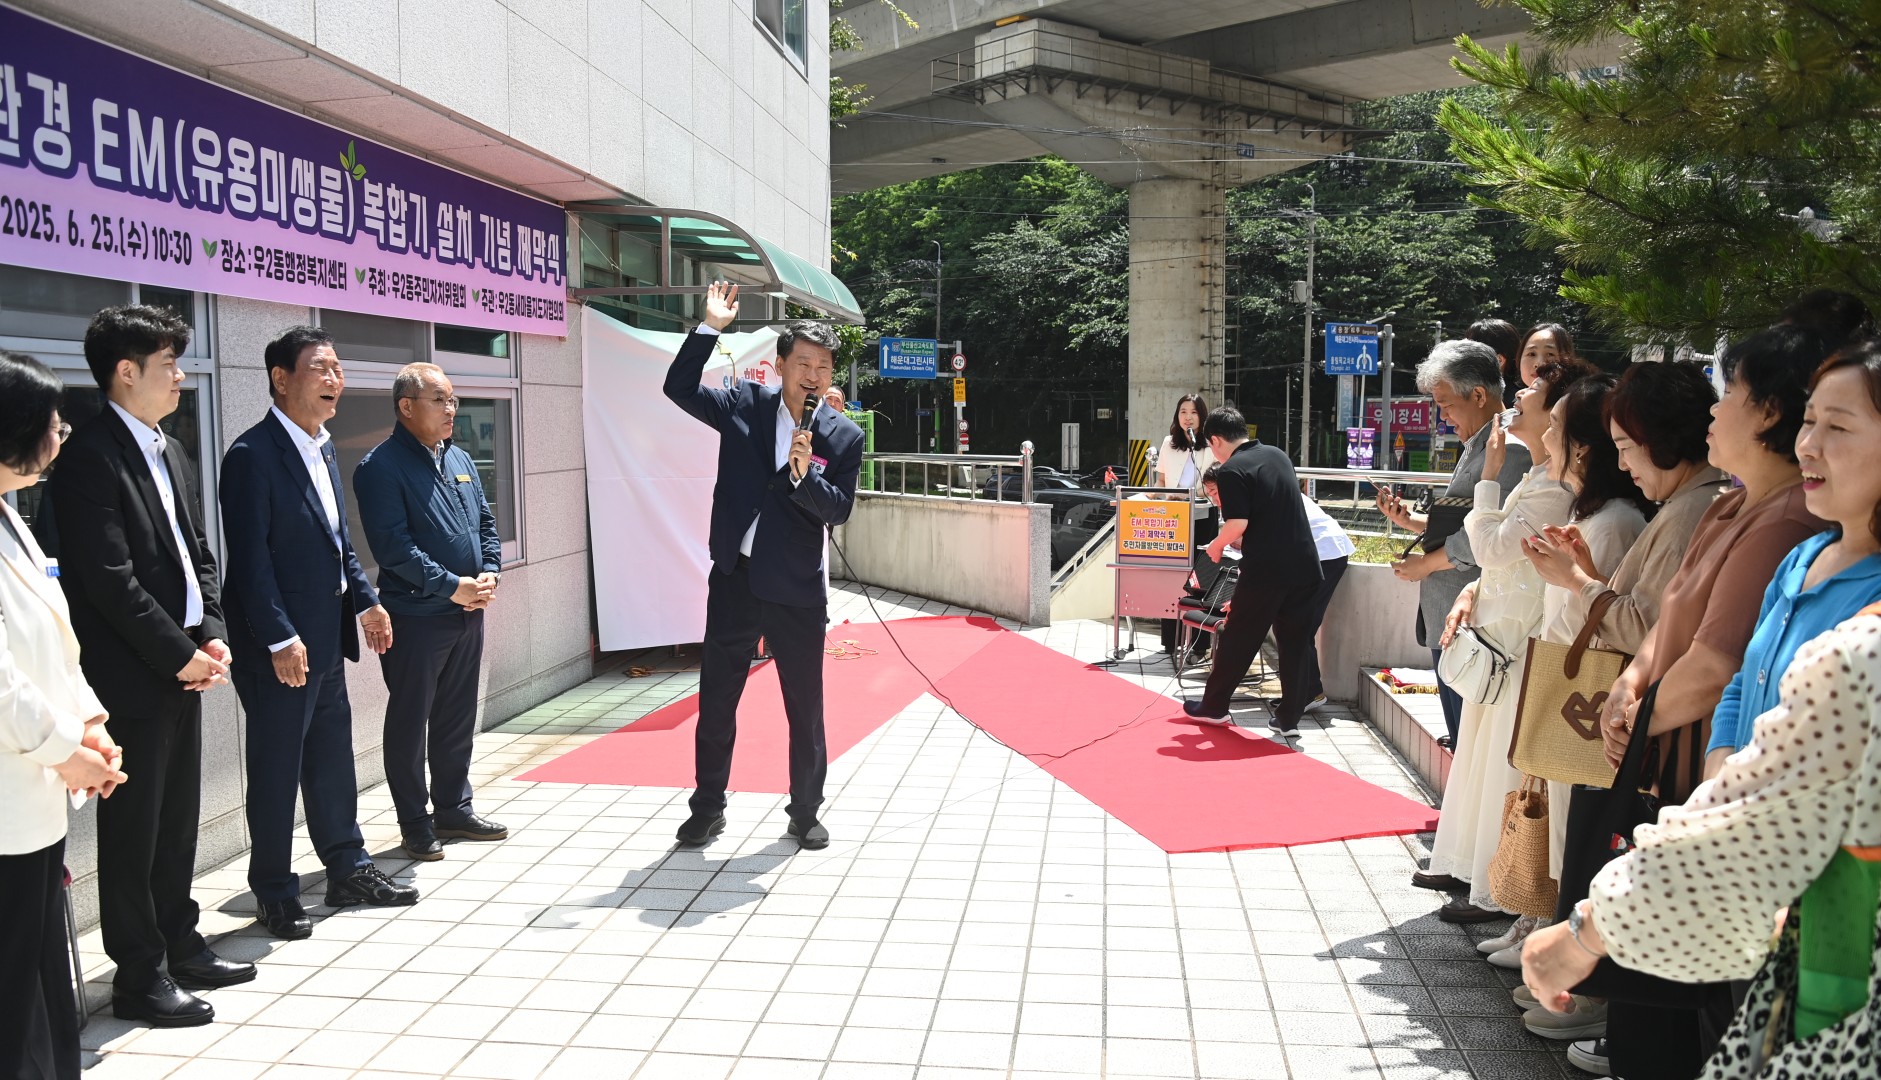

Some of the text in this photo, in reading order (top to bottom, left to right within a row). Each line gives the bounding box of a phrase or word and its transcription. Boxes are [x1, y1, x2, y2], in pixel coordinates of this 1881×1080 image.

[1, 195, 192, 265] 2025. 6. 25.(수) 10:30
[364, 178, 428, 253] 복합기
[437, 202, 473, 263] 설치
[480, 214, 512, 271] 기념
[517, 225, 560, 281] 제막식
[890, 355, 935, 366] 해운대그린시티
[1131, 518, 1178, 528] EM 복합기 설치
[1133, 529, 1175, 540] 기념 제막식 및
[1166, 542, 1185, 552] 발대식
